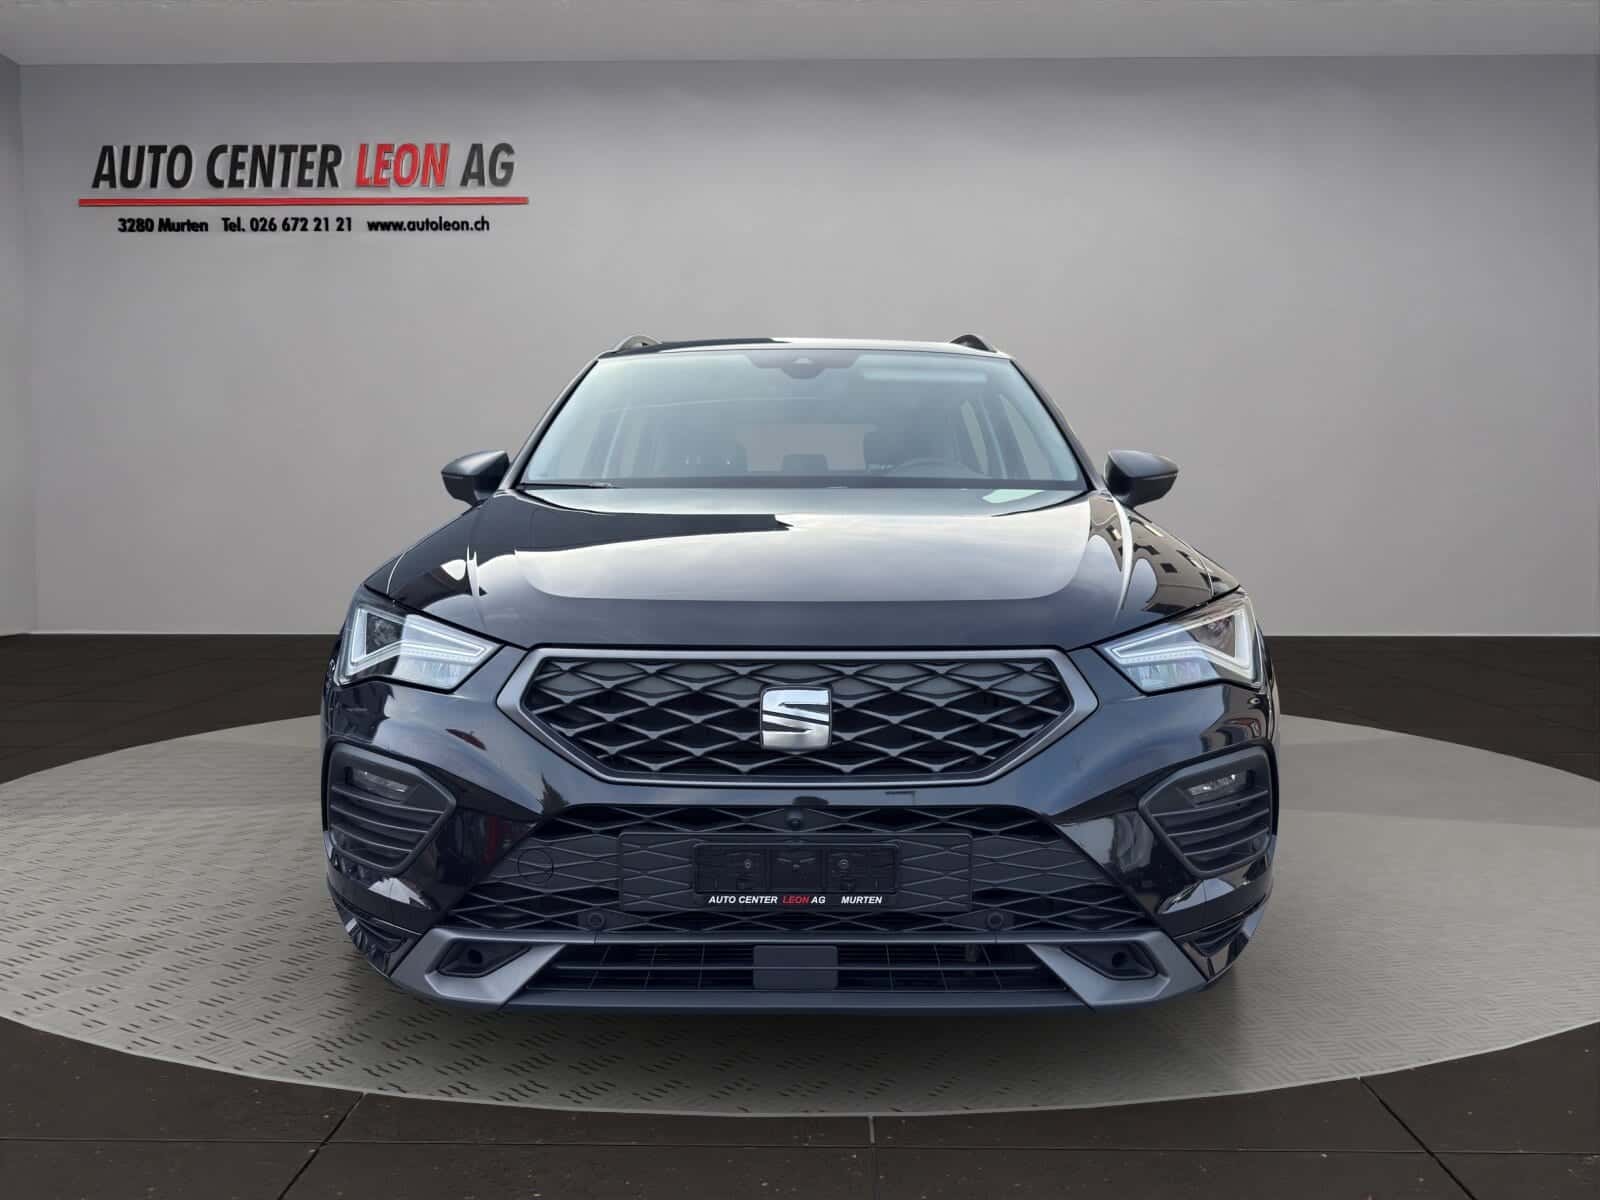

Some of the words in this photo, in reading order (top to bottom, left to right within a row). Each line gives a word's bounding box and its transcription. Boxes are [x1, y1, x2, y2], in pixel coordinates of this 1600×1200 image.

[92, 144, 194, 189] AUTO
[206, 143, 343, 188] CENTER
[355, 143, 450, 187] LEON
[460, 143, 515, 187] AG
[117, 218, 155, 233] 3280
[157, 218, 209, 233] Murten
[222, 218, 246, 233] Tel.
[249, 218, 280, 232] 026
[281, 218, 309, 232] 672
[311, 217, 330, 232] 21
[333, 217, 353, 232] 21
[367, 217, 490, 233] www.autoleon.ch
[708, 895, 737, 905] AUTO
[738, 895, 778, 905] CENTER
[782, 895, 810, 905] LEON
[811, 895, 826, 905] AG
[840, 895, 883, 905] MURTEN
